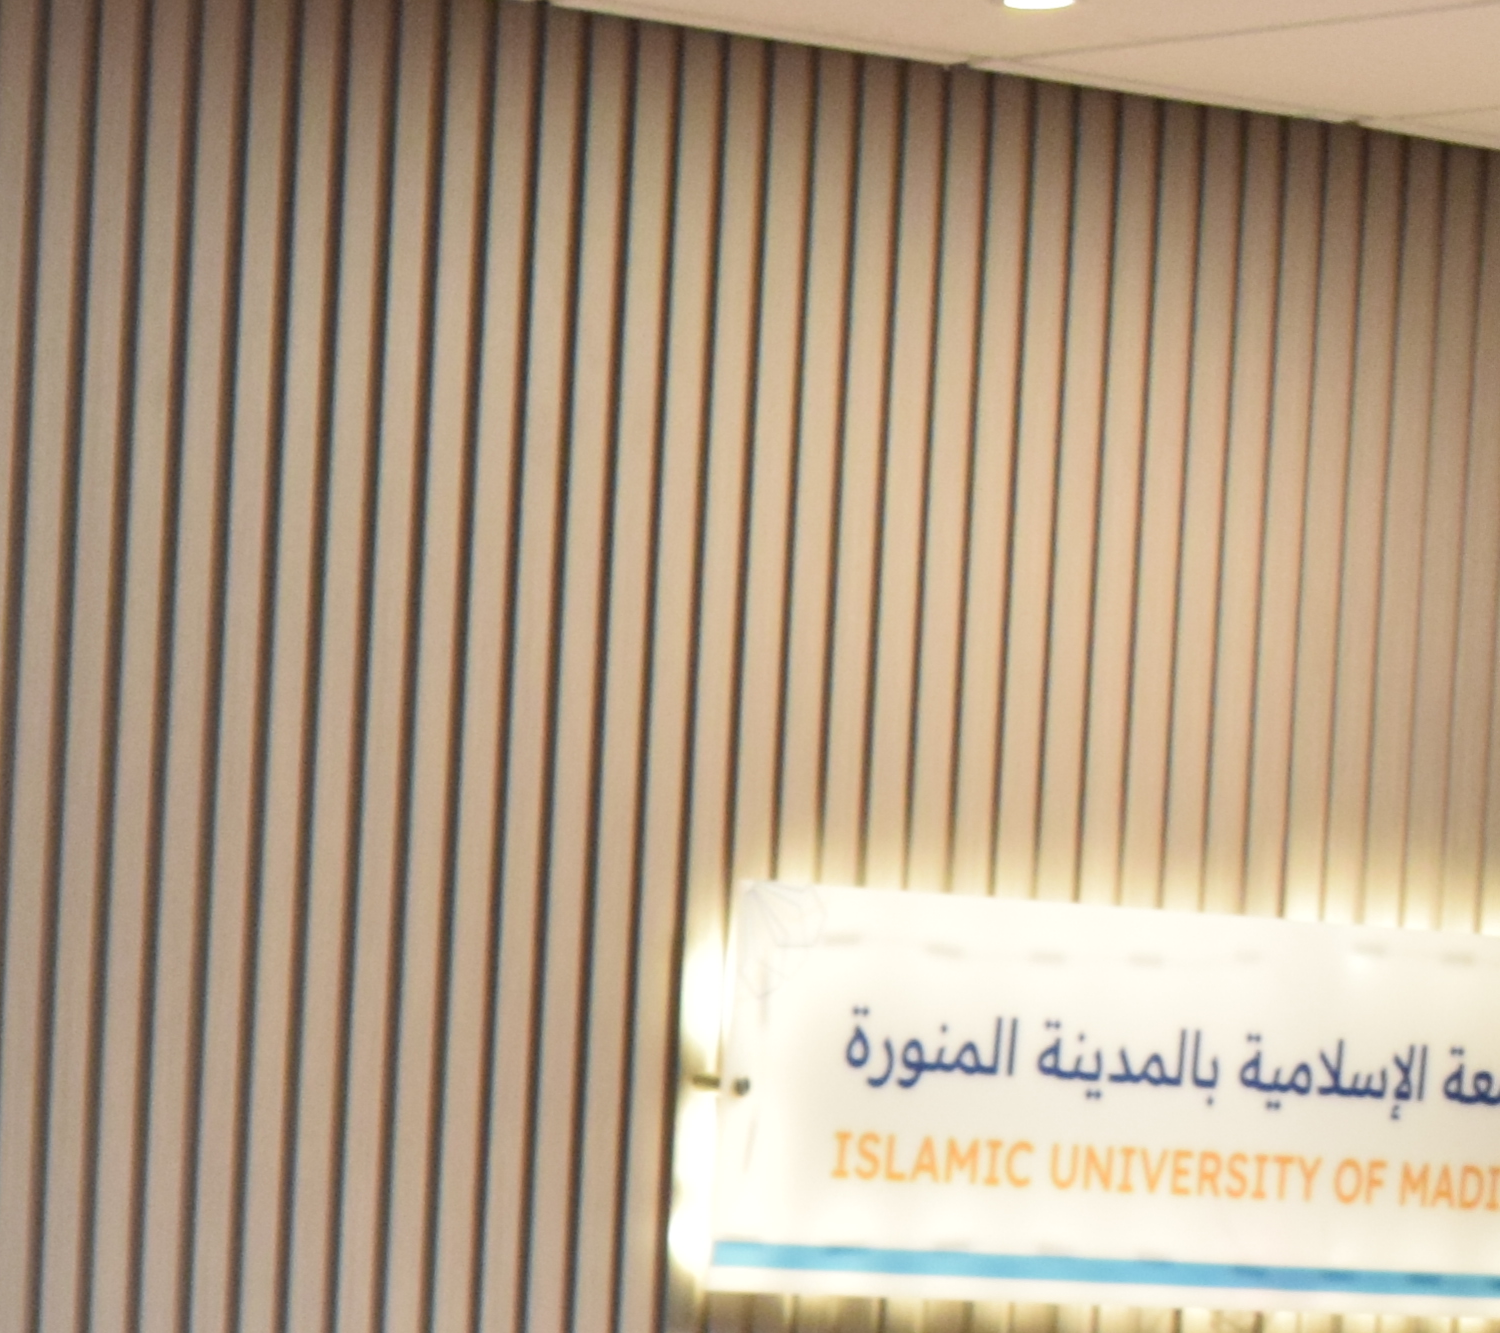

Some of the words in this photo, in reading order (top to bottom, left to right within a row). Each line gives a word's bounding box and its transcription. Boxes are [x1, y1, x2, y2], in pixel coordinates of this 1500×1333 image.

[845, 1008, 1017, 1089] المنورة
[1037, 1022, 1219, 1105] بالمدينة
[1239, 1035, 1427, 1120] الإسلامية
[832, 1131, 1033, 1187] ISLAMIC
[1048, 1144, 1322, 1202] UNIVERSITY
[1332, 1157, 1388, 1205] OF
